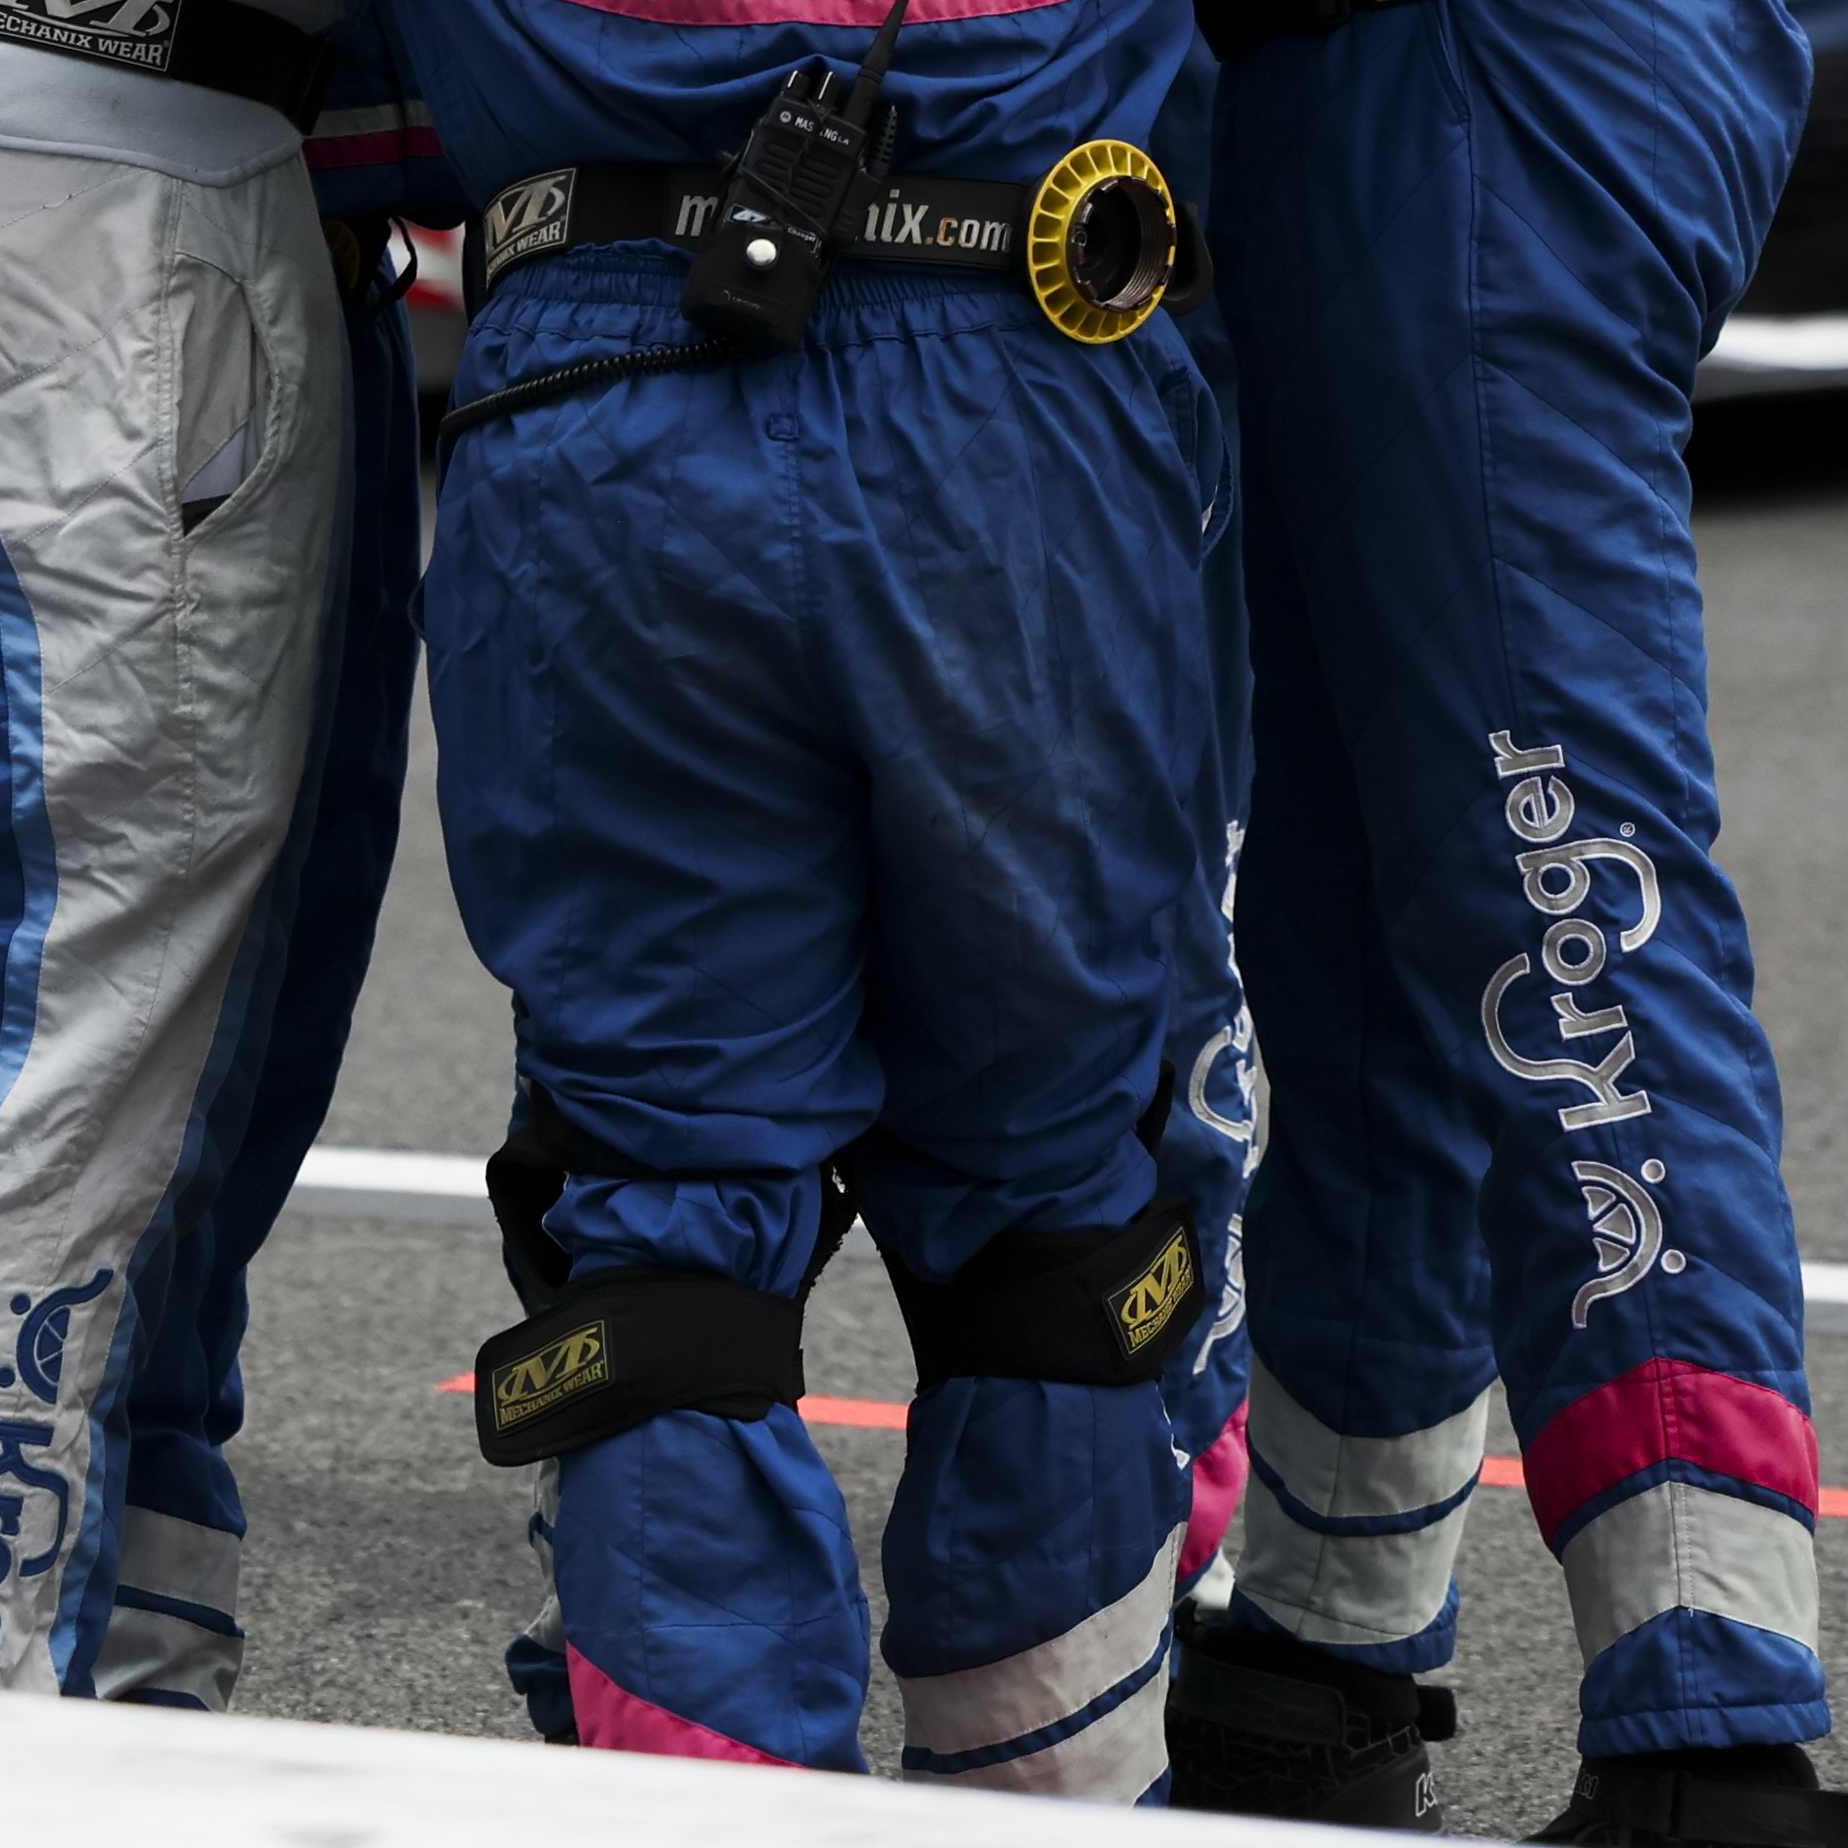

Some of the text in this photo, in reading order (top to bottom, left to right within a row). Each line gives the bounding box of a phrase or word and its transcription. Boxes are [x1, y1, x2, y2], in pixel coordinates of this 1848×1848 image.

[97, 37, 164, 67] WEAR
[516, 220, 562, 253] WEAR
[1480, 728, 1662, 1134] Kroger
[1127, 1263, 1195, 1348] MECHANIX WEAR
[499, 1359, 607, 1426] MECHANIX WEAR
